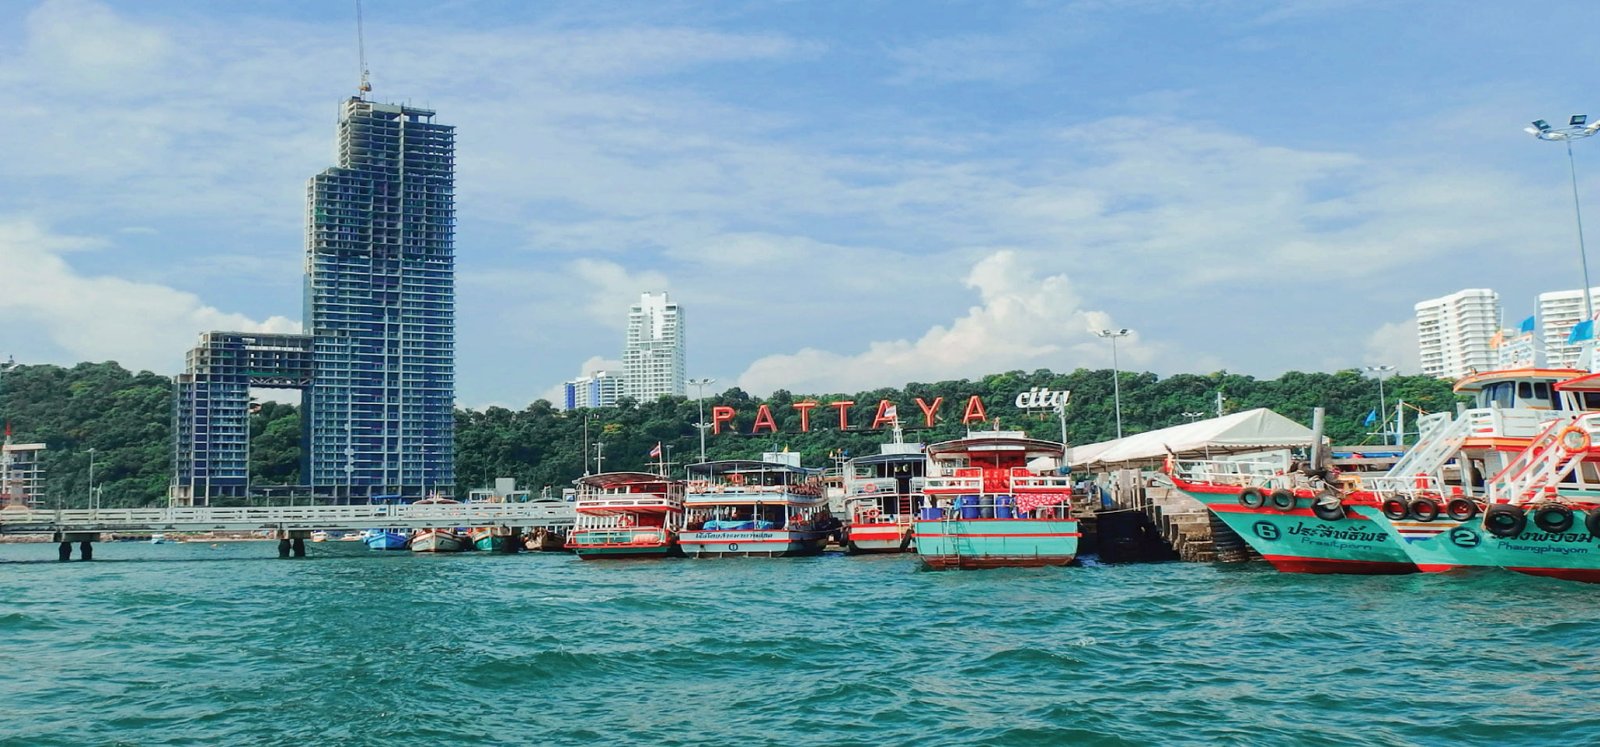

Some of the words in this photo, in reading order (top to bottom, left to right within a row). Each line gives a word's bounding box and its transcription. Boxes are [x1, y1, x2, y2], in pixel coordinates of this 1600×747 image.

[713, 394, 987, 435] PATTAYA
[1015, 386, 1071, 413] city
[1255, 522, 1279, 540] 6
[1452, 528, 1478, 547] 2
